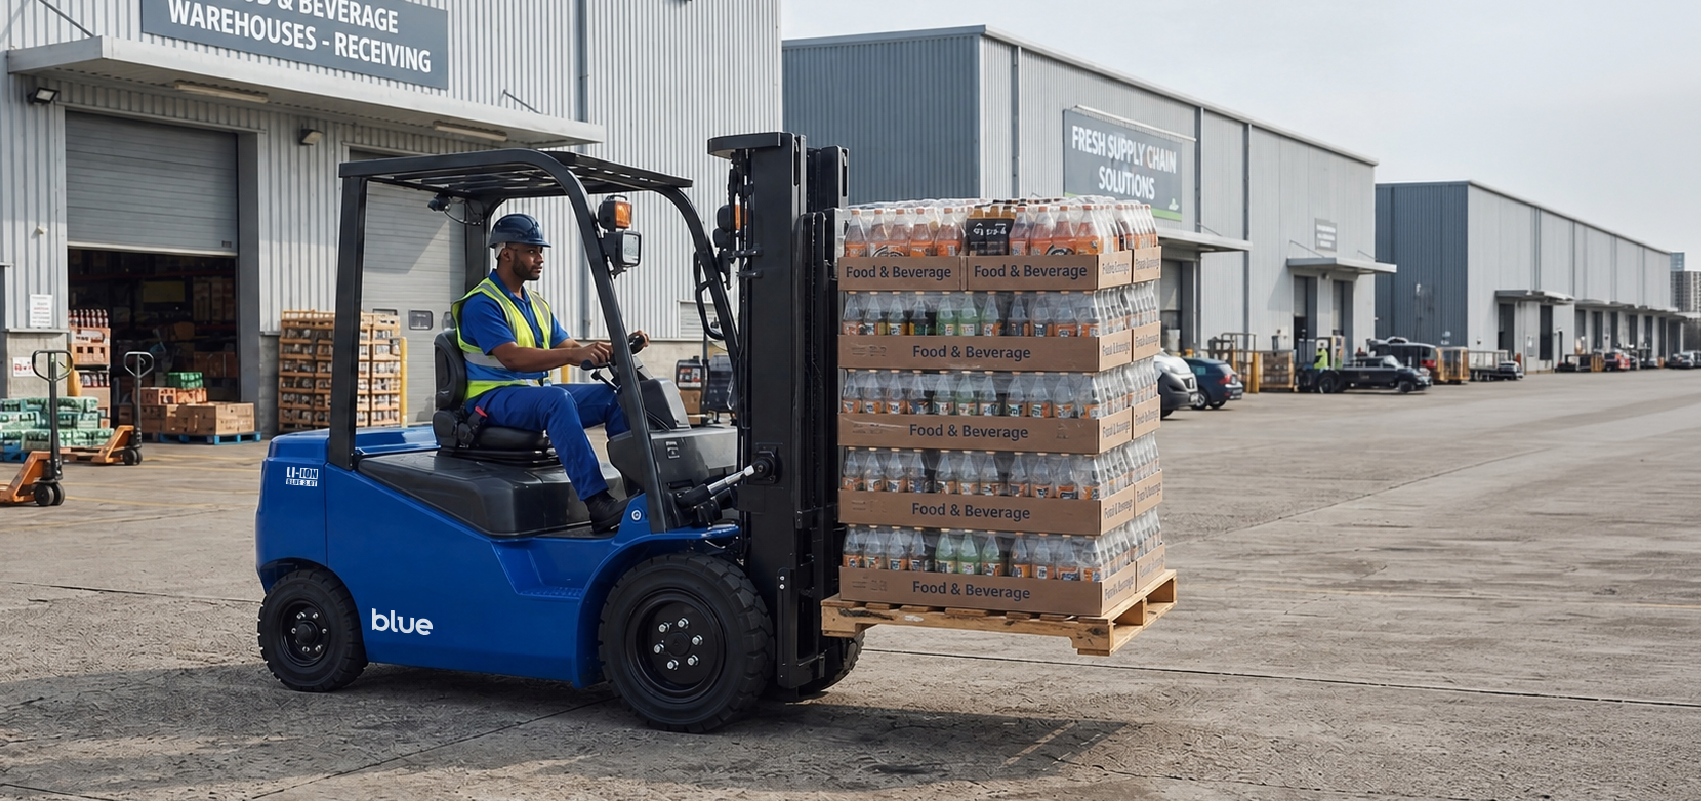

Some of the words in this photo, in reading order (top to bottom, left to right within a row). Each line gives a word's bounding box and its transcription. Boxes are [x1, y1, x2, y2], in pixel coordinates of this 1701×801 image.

[299, 0, 399, 33] BEVERAGE
[168, 0, 317, 50] WAREHOUSES
[334, 31, 431, 73] RECEIVING
[1072, 125, 1106, 156] FRESH
[1107, 134, 1146, 167] SUPPLY
[1146, 145, 1177, 174] CHAIN
[1099, 165, 1155, 200] SOLUTIONS
[846, 265, 876, 278] Food
[879, 266, 890, 278] &
[892, 266, 951, 280] Beverage
[974, 264, 1006, 278] Food
[1010, 265, 1020, 277] &
[1024, 265, 1088, 280] Beverage
[912, 345, 947, 358] Food
[950, 346, 961, 358] &
[966, 346, 1031, 361] Beverage
[909, 424, 944, 437] Food
[947, 425, 958, 437] &
[963, 425, 1029, 441] Beverage
[286, 466, 319, 480] LI-ION
[912, 502, 946, 516] Food
[950, 504, 960, 517] &
[965, 504, 1030, 522] Beverage
[912, 581, 947, 594] Food
[951, 582, 961, 595] &
[966, 583, 1030, 601] Beverage
[371, 608, 434, 636] blue
